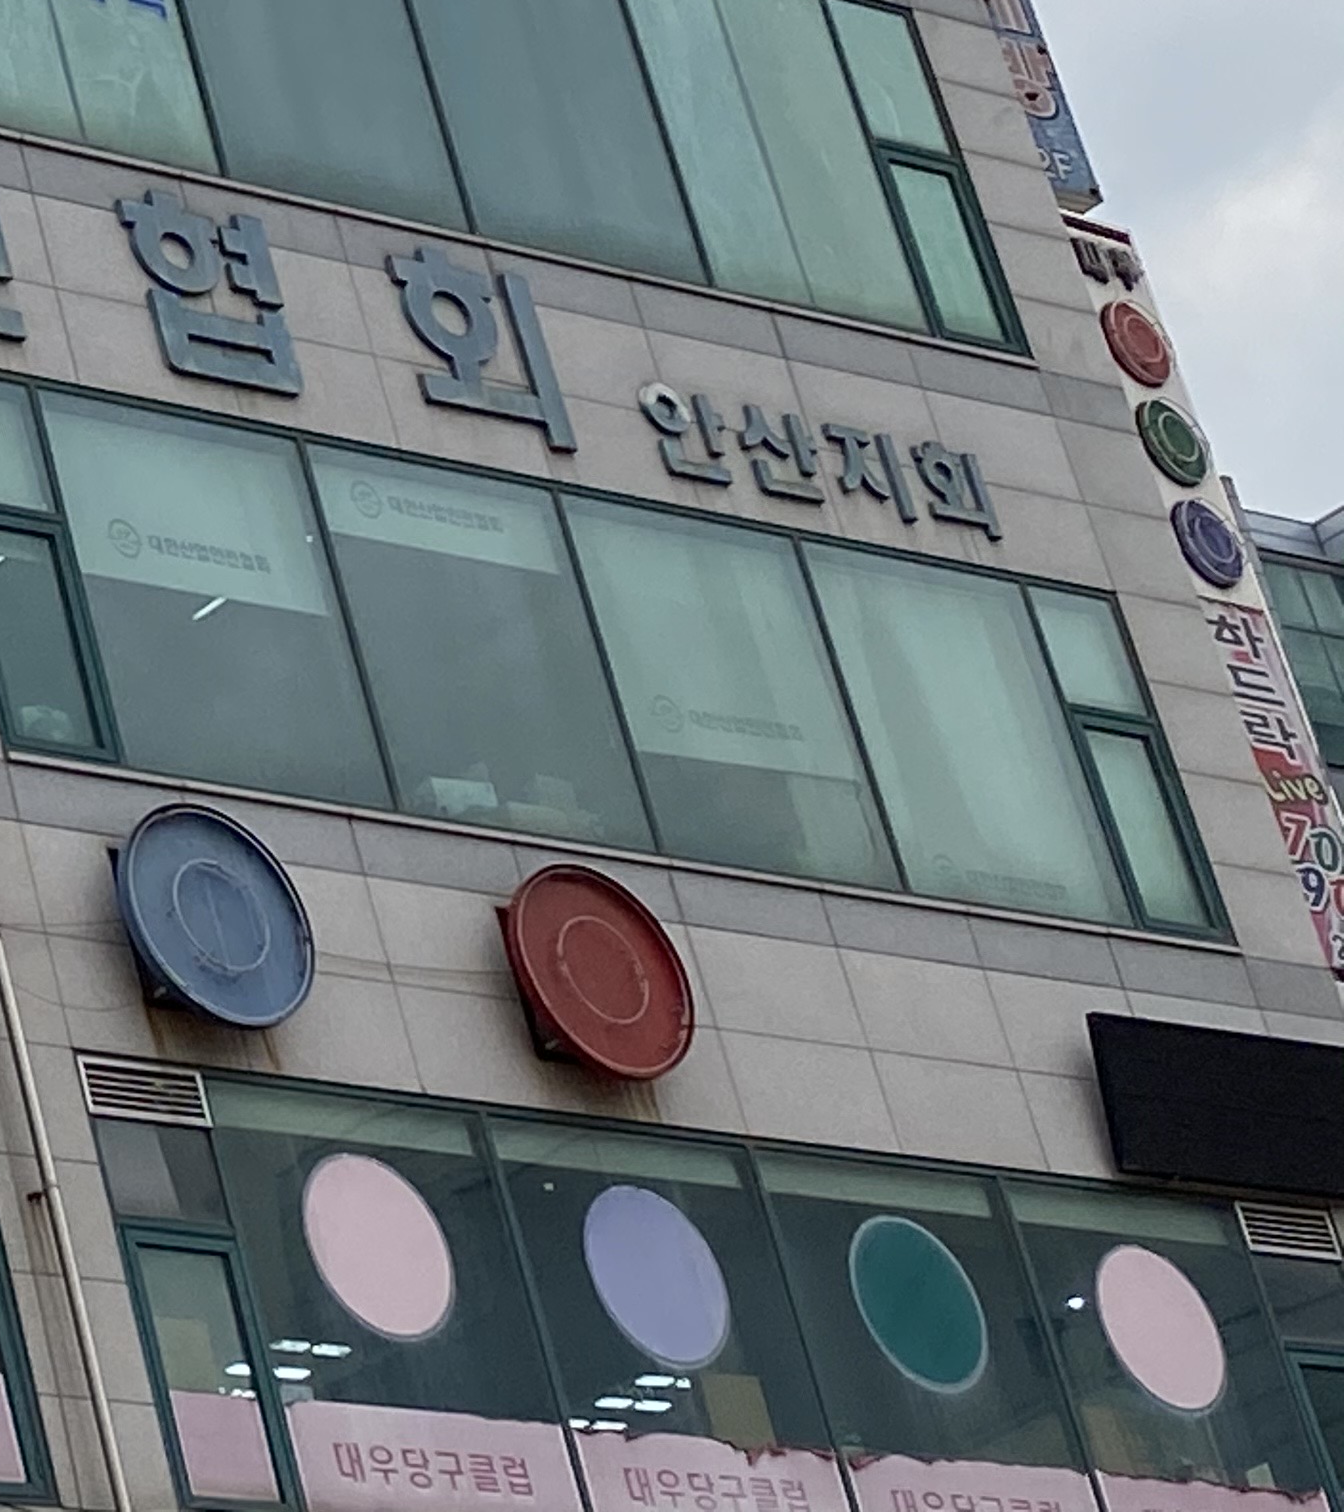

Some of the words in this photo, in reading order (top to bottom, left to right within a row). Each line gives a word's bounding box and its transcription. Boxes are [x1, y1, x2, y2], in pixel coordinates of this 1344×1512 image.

[639, 381, 1002, 542] 안산지회
[1205, 614, 1298, 761] 하드락
[332, 1441, 534, 1496] 대우당구클럽
